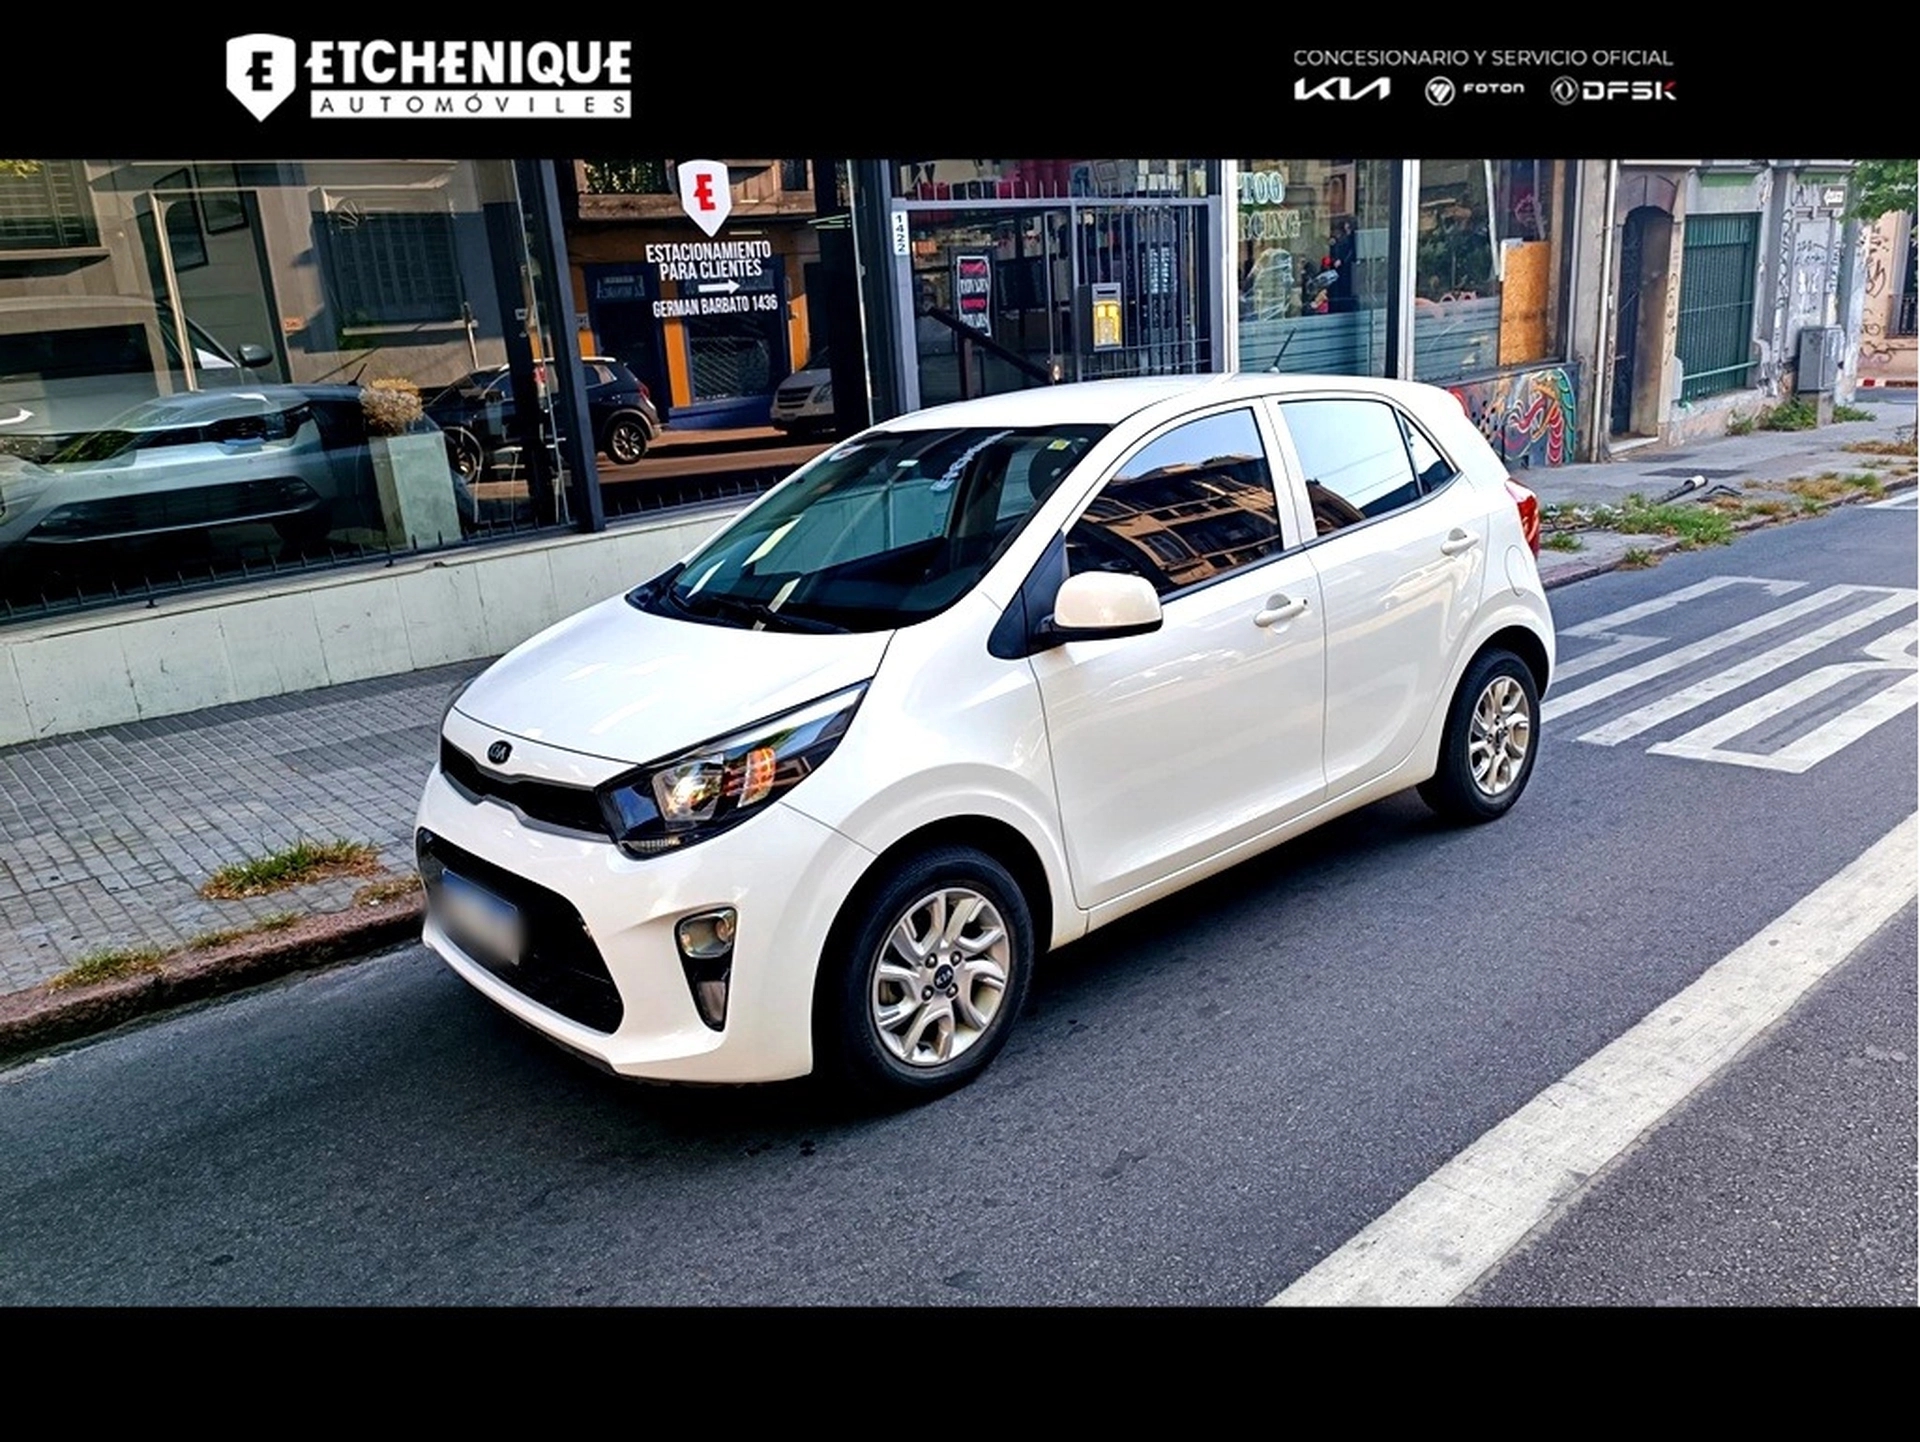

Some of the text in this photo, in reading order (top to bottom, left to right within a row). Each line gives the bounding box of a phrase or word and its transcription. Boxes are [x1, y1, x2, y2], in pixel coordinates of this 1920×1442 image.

[896, 214, 906, 253] 1422
[645, 241, 771, 262] ESTACIONAMIENTO
[659, 259, 762, 281] PARA CLIENTES
[652, 294, 778, 318] GERMAN BARBATO 1436
